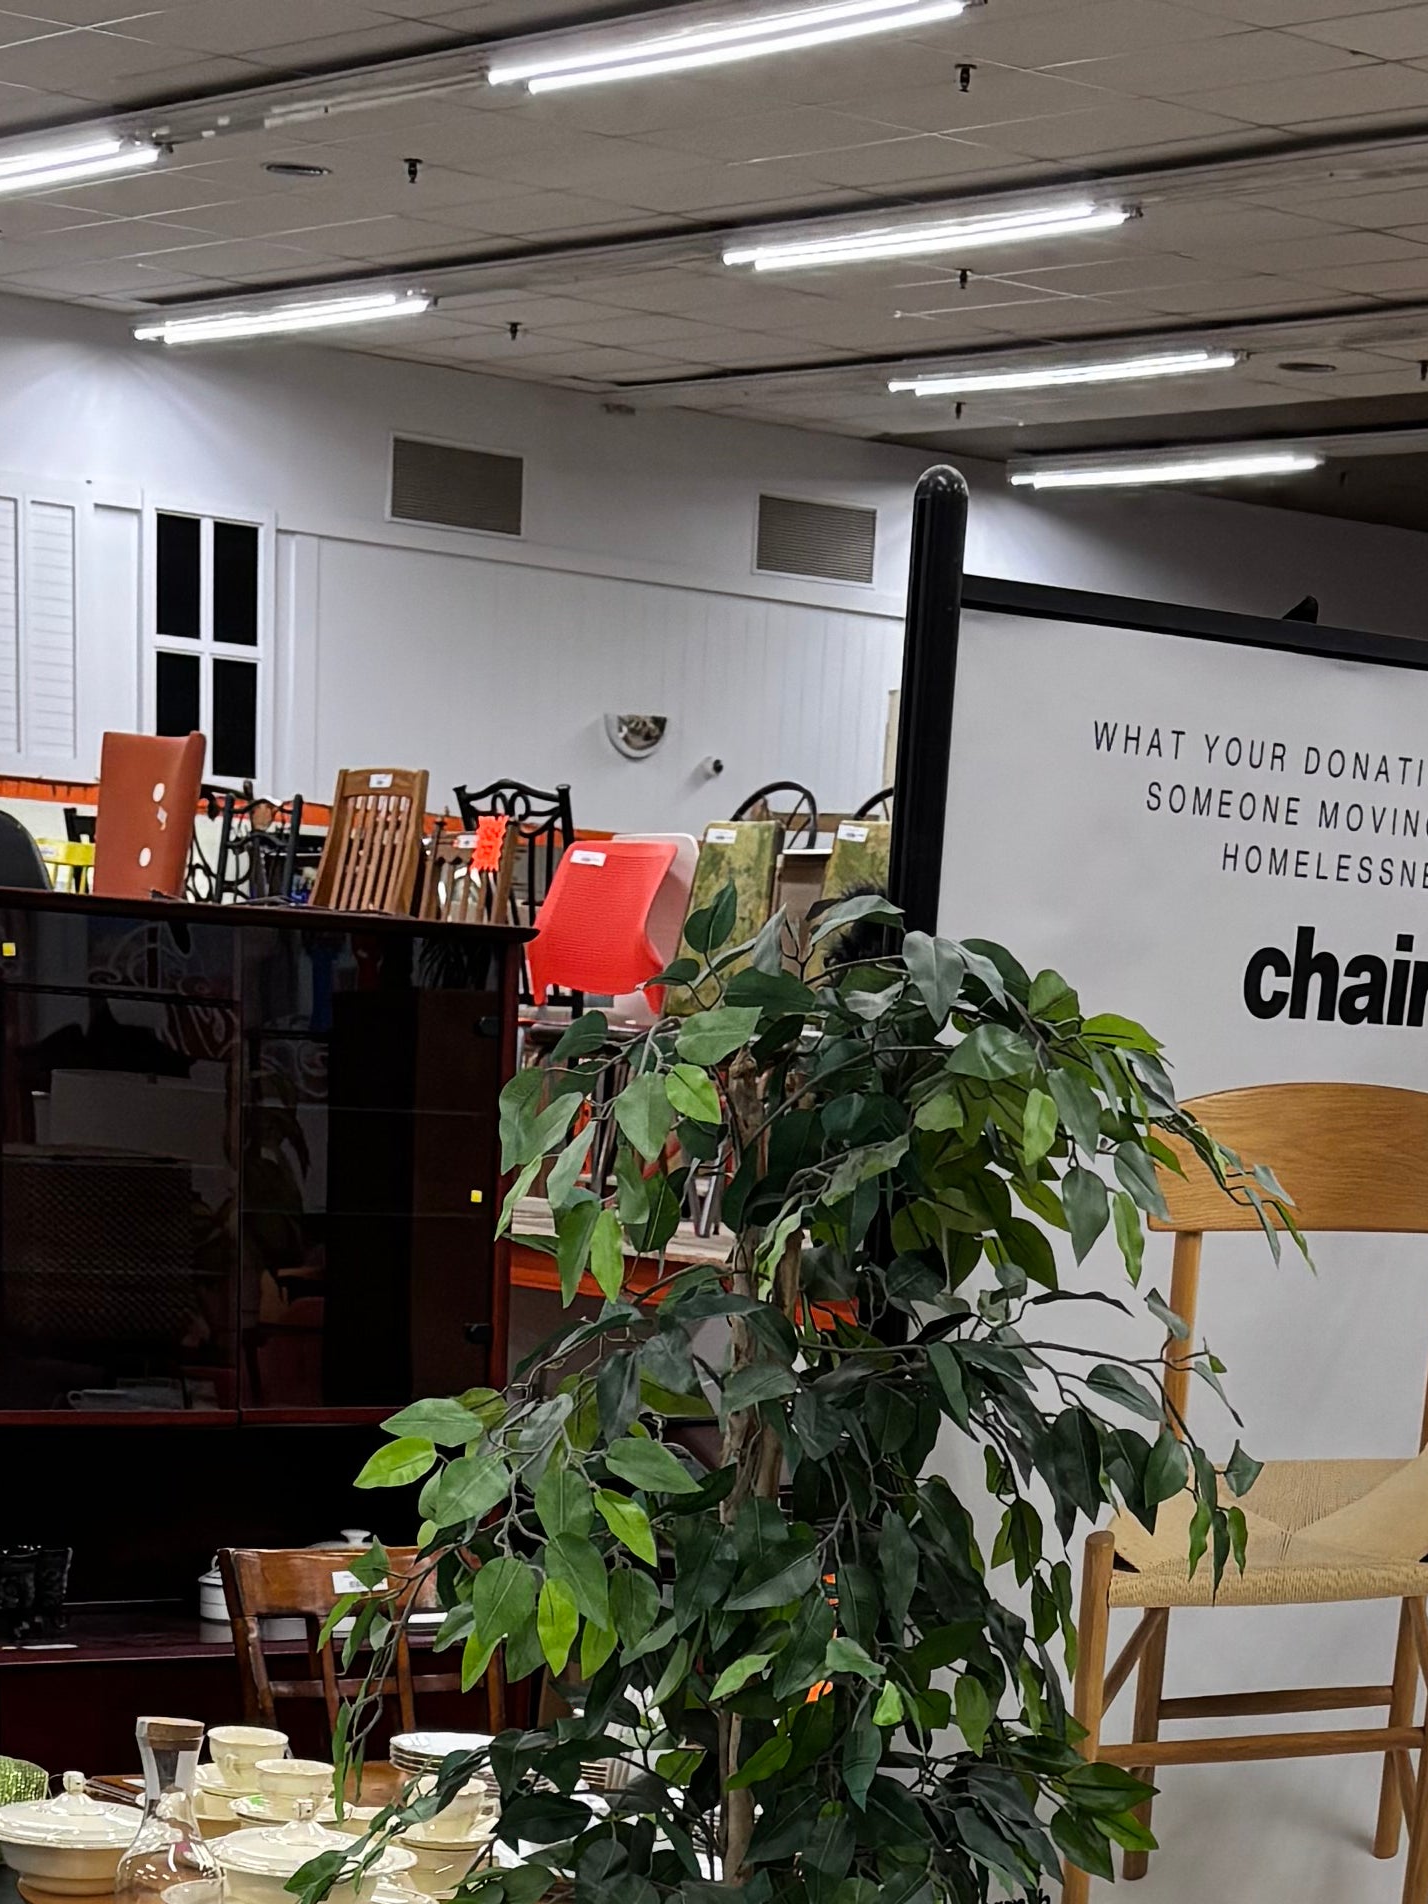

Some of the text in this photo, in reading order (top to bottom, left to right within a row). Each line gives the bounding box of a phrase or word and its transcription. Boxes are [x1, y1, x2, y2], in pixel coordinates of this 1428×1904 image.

[1093, 720, 1186, 762] WHAT
[1204, 732, 1288, 772] YOUR
[1145, 781, 1301, 827] SOMEONE
